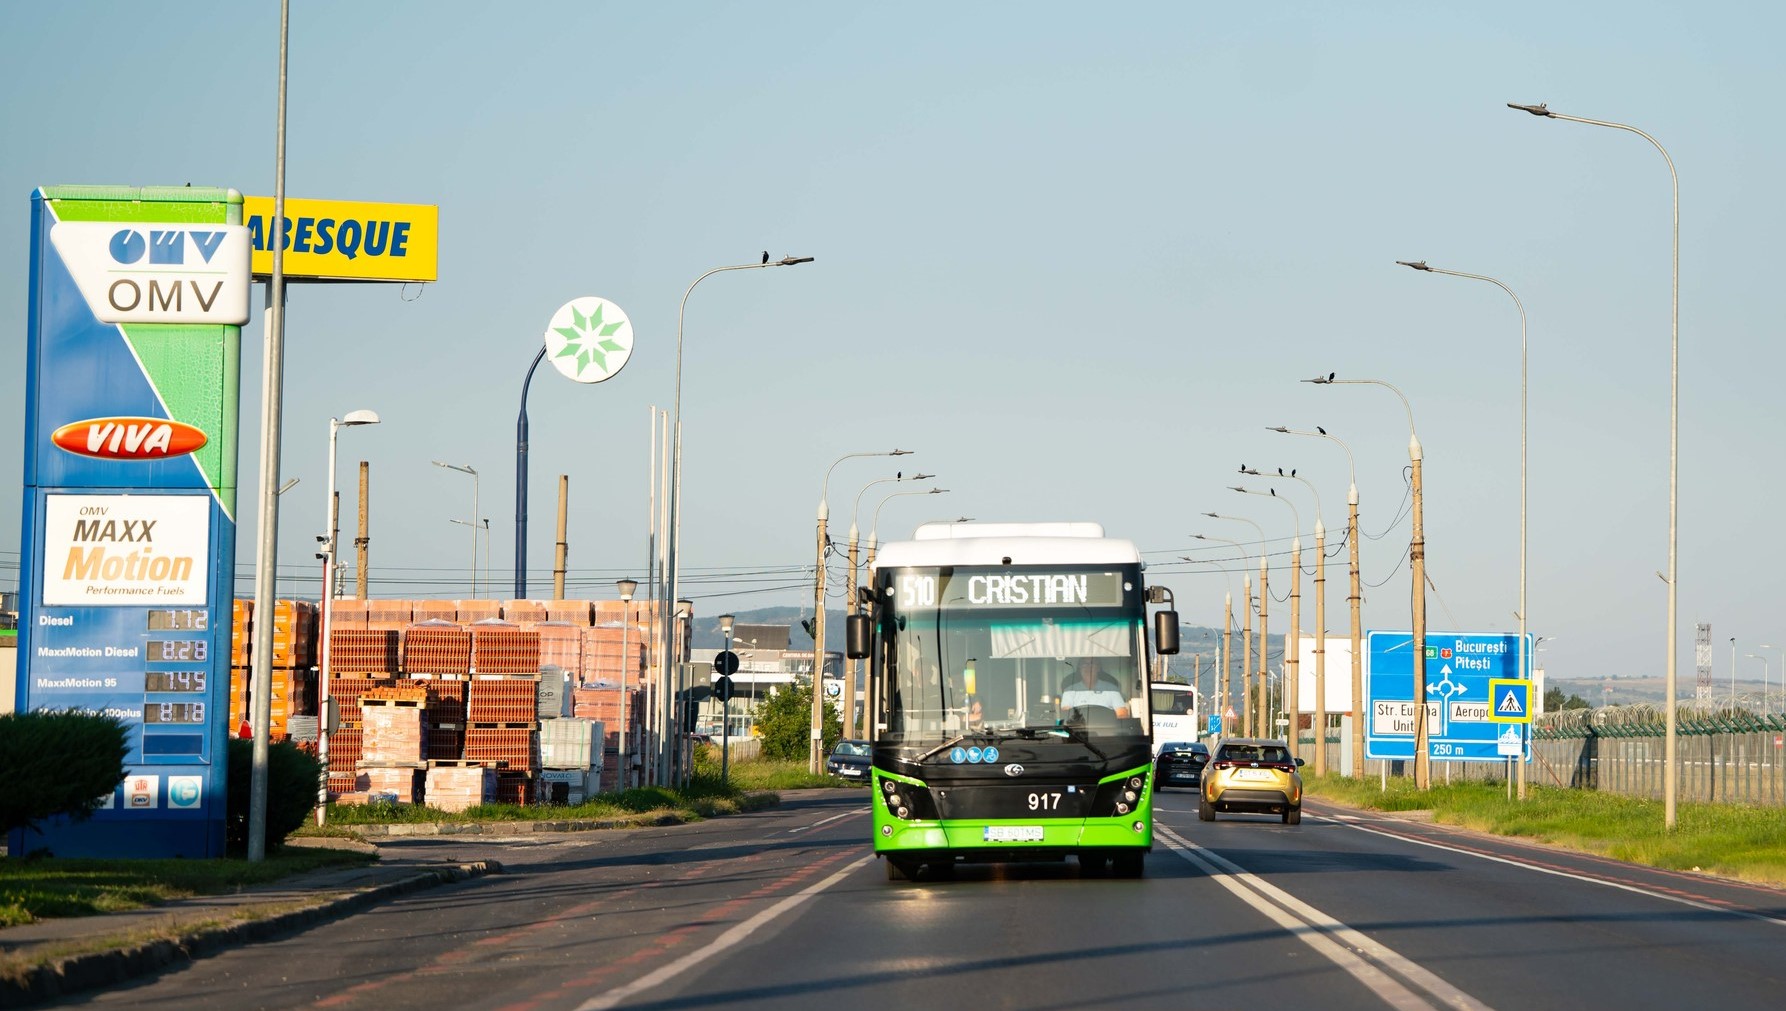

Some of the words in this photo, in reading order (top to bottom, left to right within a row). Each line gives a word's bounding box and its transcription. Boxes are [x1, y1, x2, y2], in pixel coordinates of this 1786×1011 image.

[108, 279, 224, 312] OMV
[86, 422, 173, 453] VIVA
[79, 507, 109, 516] OMV
[73, 520, 157, 542] MAXX
[62, 547, 194, 581] Motion
[85, 586, 154, 595] Performance
[157, 586, 185, 595] Fuels
[903, 575, 935, 606] 510
[968, 574, 1088, 604] CRISTIAN
[39, 616, 73, 626] Diesel
[166, 610, 208, 629] 7.72
[38, 647, 102, 657] MaxxMotion
[104, 647, 138, 657] Diesel
[162, 641, 207, 660] 8.28
[1455, 640, 1507, 655] București
[1455, 656, 1491, 671] Pitești
[37, 678, 102, 688] MaxxMotion
[104, 678, 117, 688] 95
[164, 672, 206, 691] 7.45
[160, 702, 205, 722] 8.18
[1378, 704, 1398, 716] Str.
[1401, 704, 1437, 717] Eua
[1455, 705, 1490, 720] Aeropo
[1393, 719, 1415, 732] Unit
[1433, 744, 1452, 756] 250
[1455, 747, 1464, 756] m
[1028, 793, 1062, 811] 917
